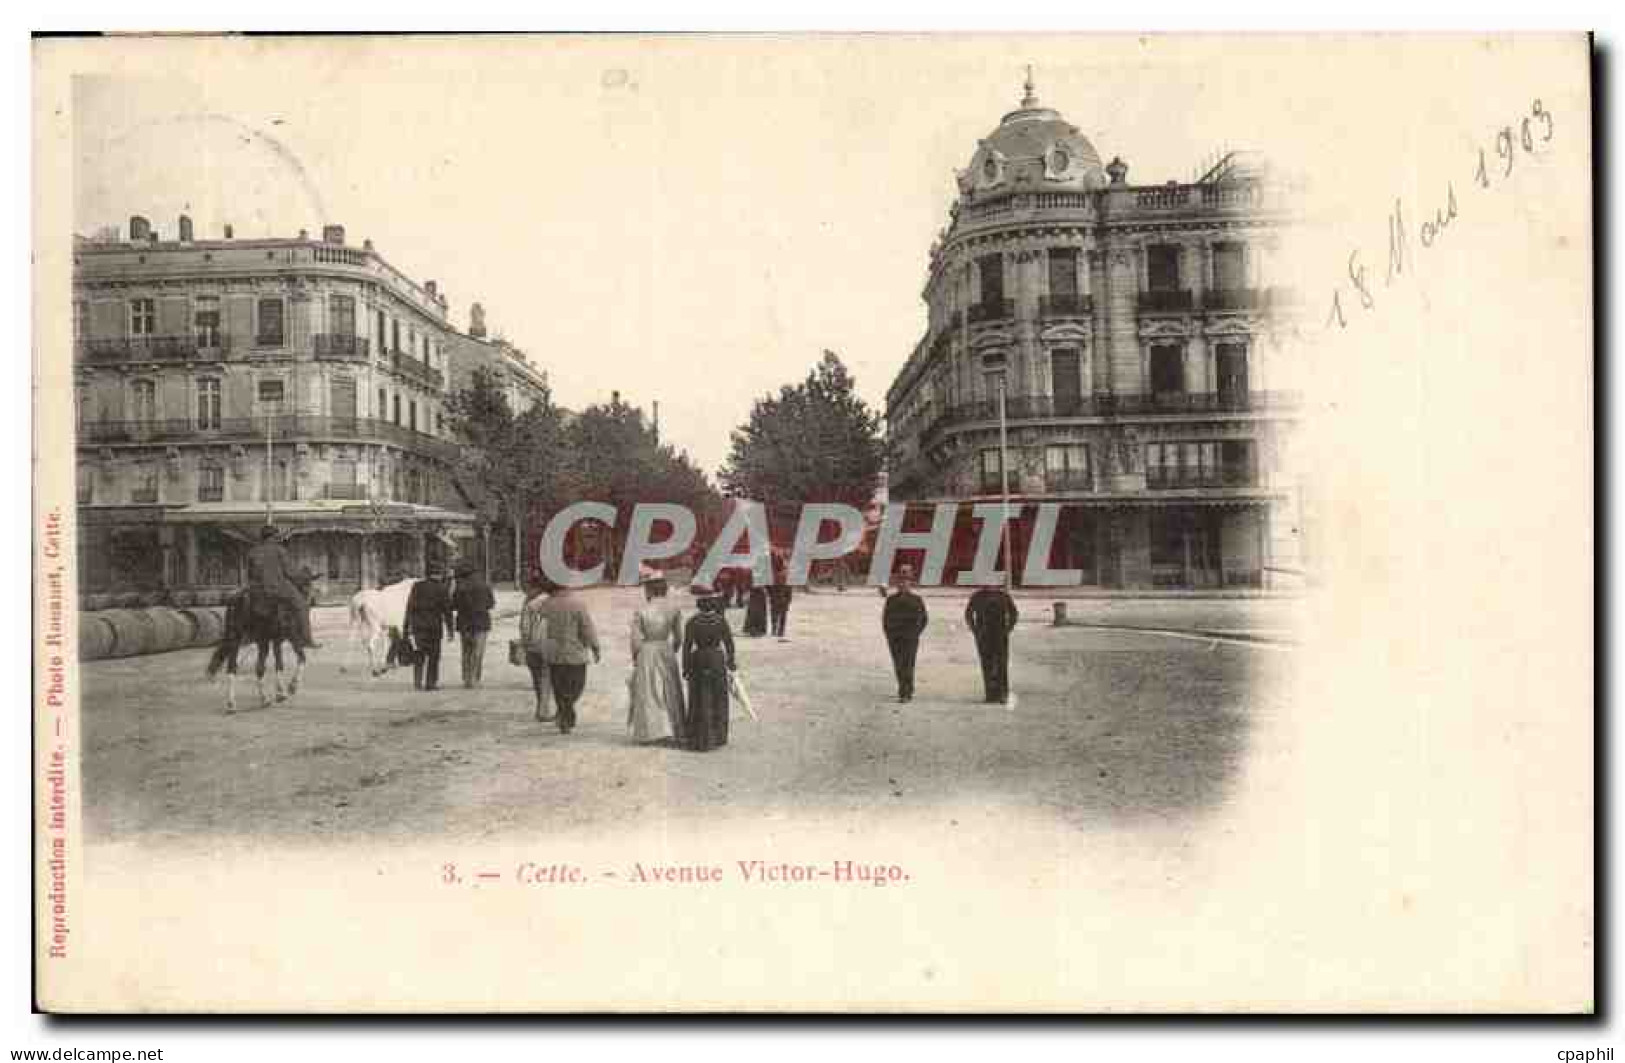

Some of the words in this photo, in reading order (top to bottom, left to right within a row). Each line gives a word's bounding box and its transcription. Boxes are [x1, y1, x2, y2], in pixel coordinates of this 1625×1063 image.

[1475, 98, 1553, 189] 1903
[44, 505, 63, 559] Cette.
[46, 655, 64, 708] Photo
[47, 744, 65, 830] interdite.
[48, 838, 68, 960] Reproduction
[441, 863, 463, 884] 3.
[515, 862, 588, 884] Cette.
[629, 862, 723, 884] Avenue
[737, 860, 911, 888] Victor-Hugo.
